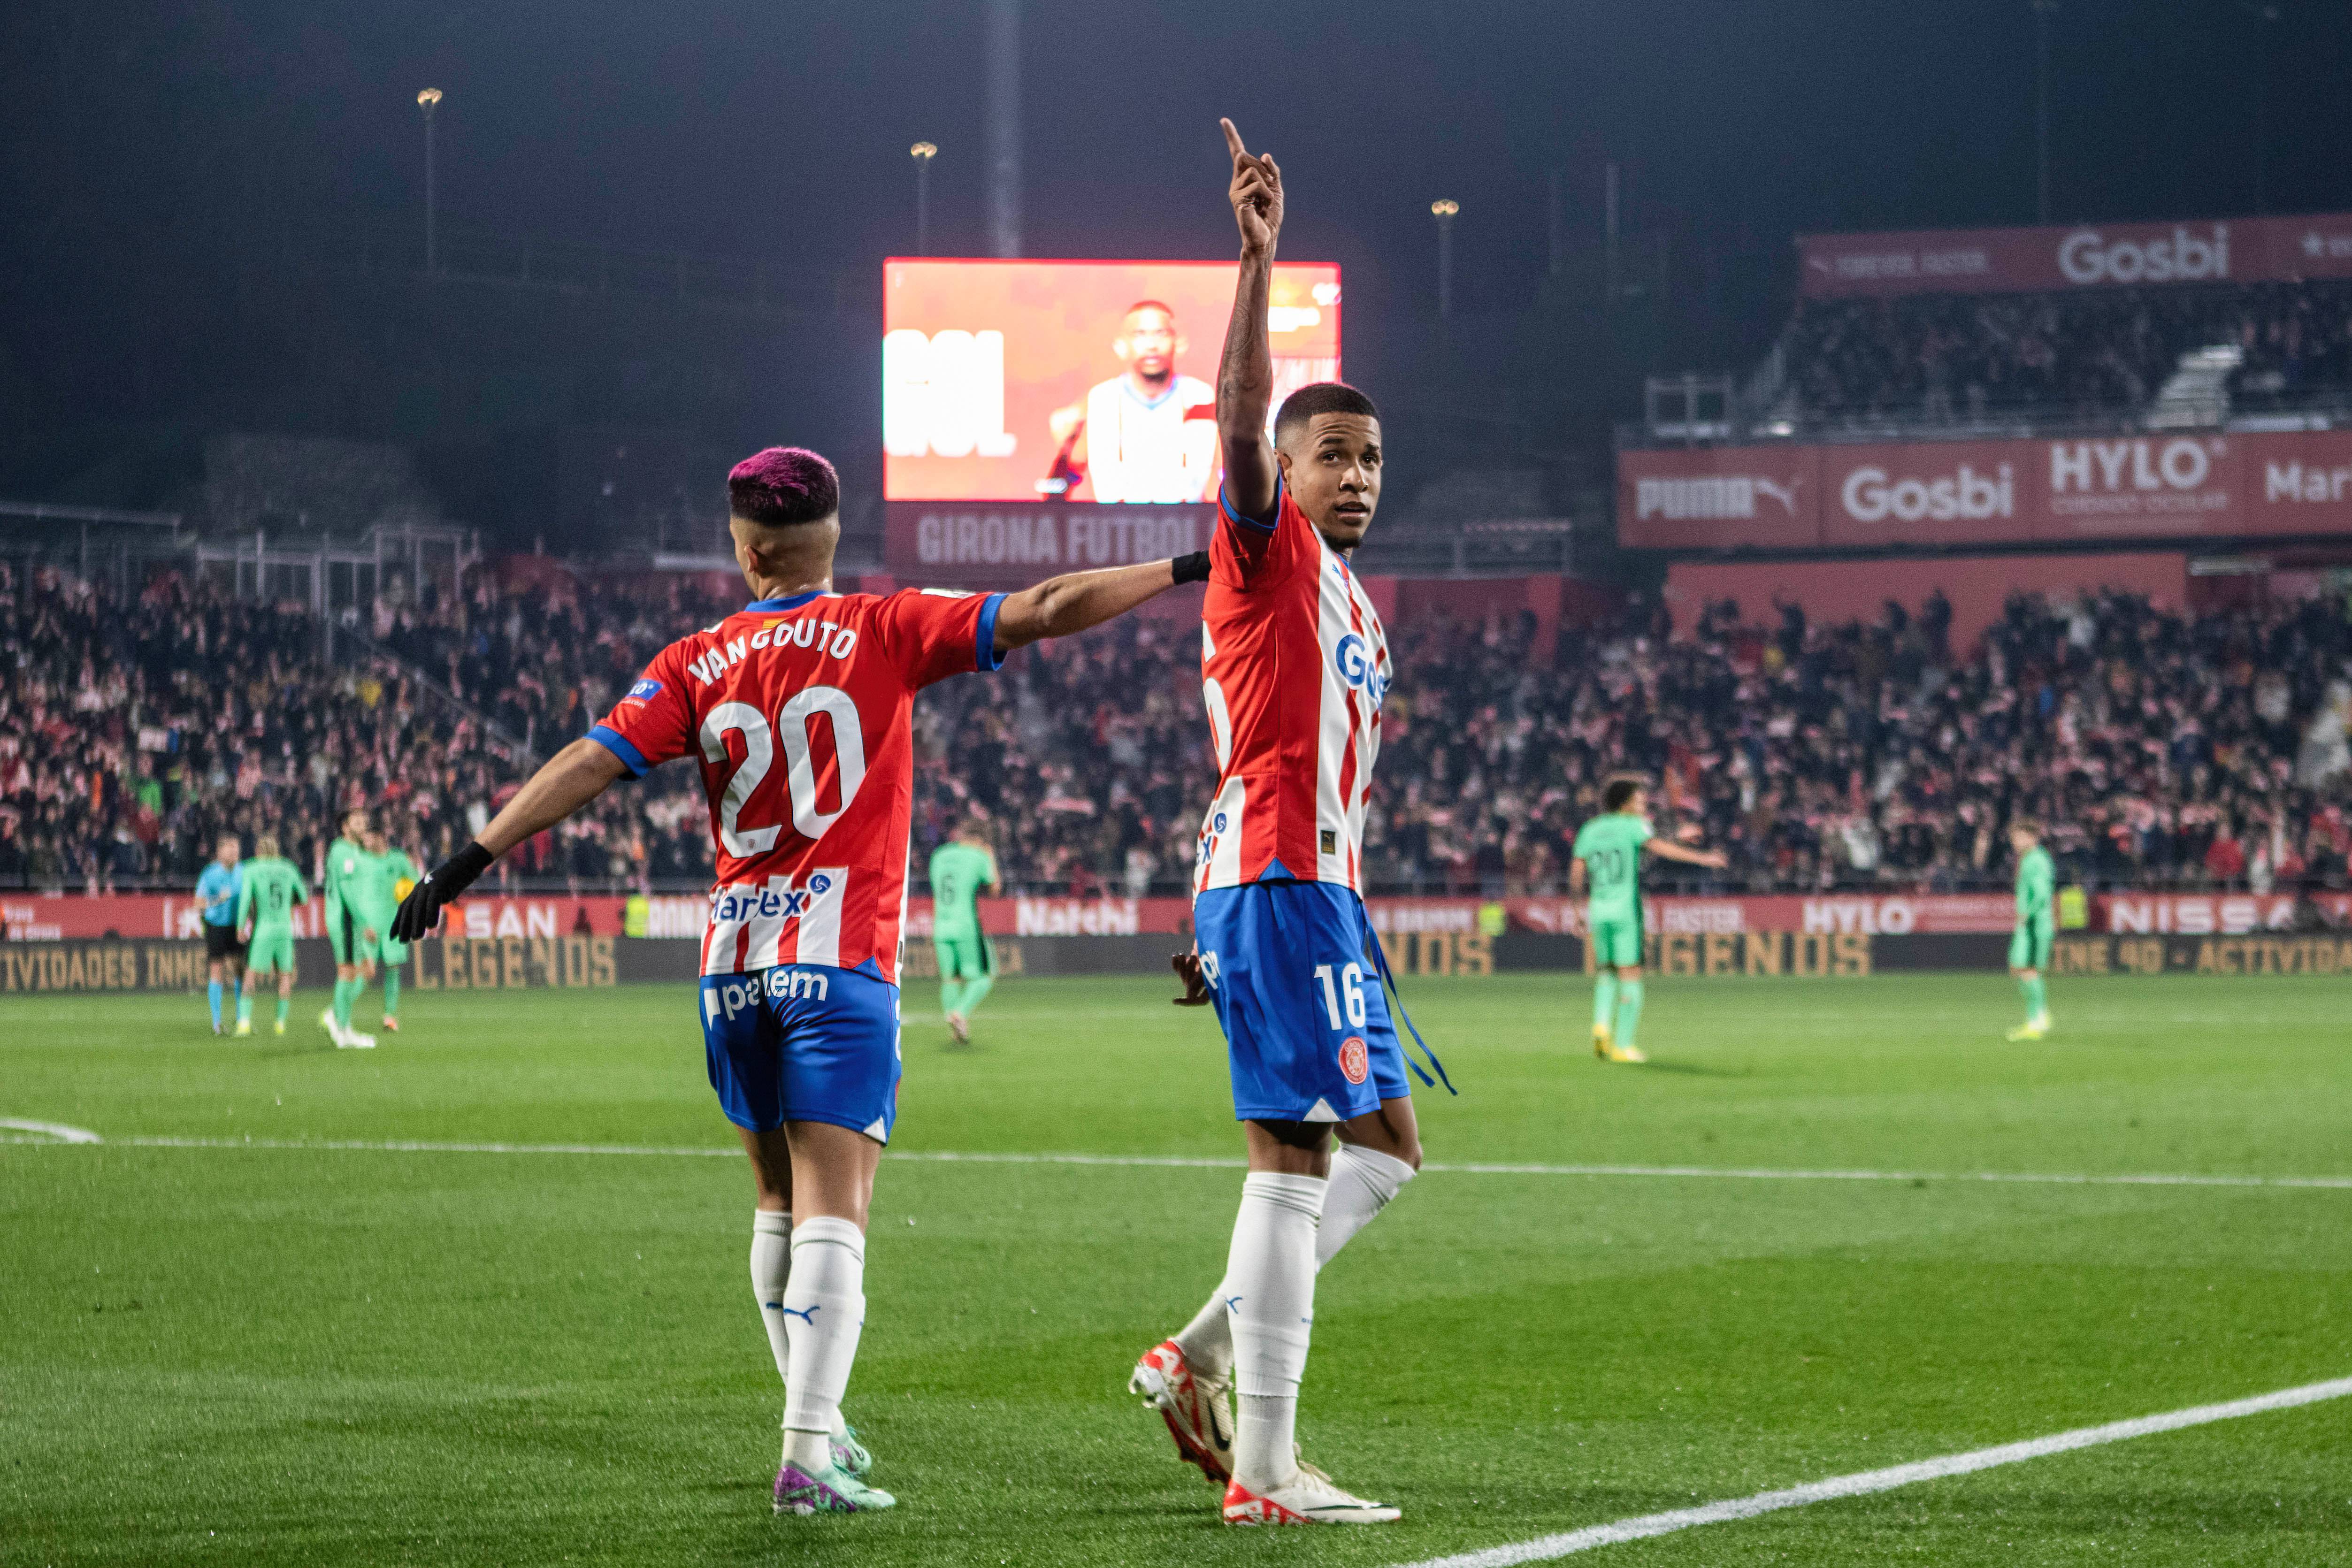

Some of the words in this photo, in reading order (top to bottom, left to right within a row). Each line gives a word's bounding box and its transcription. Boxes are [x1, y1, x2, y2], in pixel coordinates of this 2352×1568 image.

[2058, 223, 2229, 283] Gosbi
[2050, 441, 2208, 490] HYLO
[1638, 476, 1754, 519] PUMA
[1842, 466, 2013, 523] Gosbi
[918, 516, 1058, 563] GIRONA
[1068, 516, 1196, 563] FUTBOL
[688, 635, 746, 686] VAN
[751, 619, 857, 659] COUTO
[699, 685, 866, 858] 20
[1803, 898, 1914, 934] HYLO
[2111, 900, 2295, 934] NISSA
[414, 936, 616, 987] LEGENDS
[1314, 963, 1365, 1031] 16
